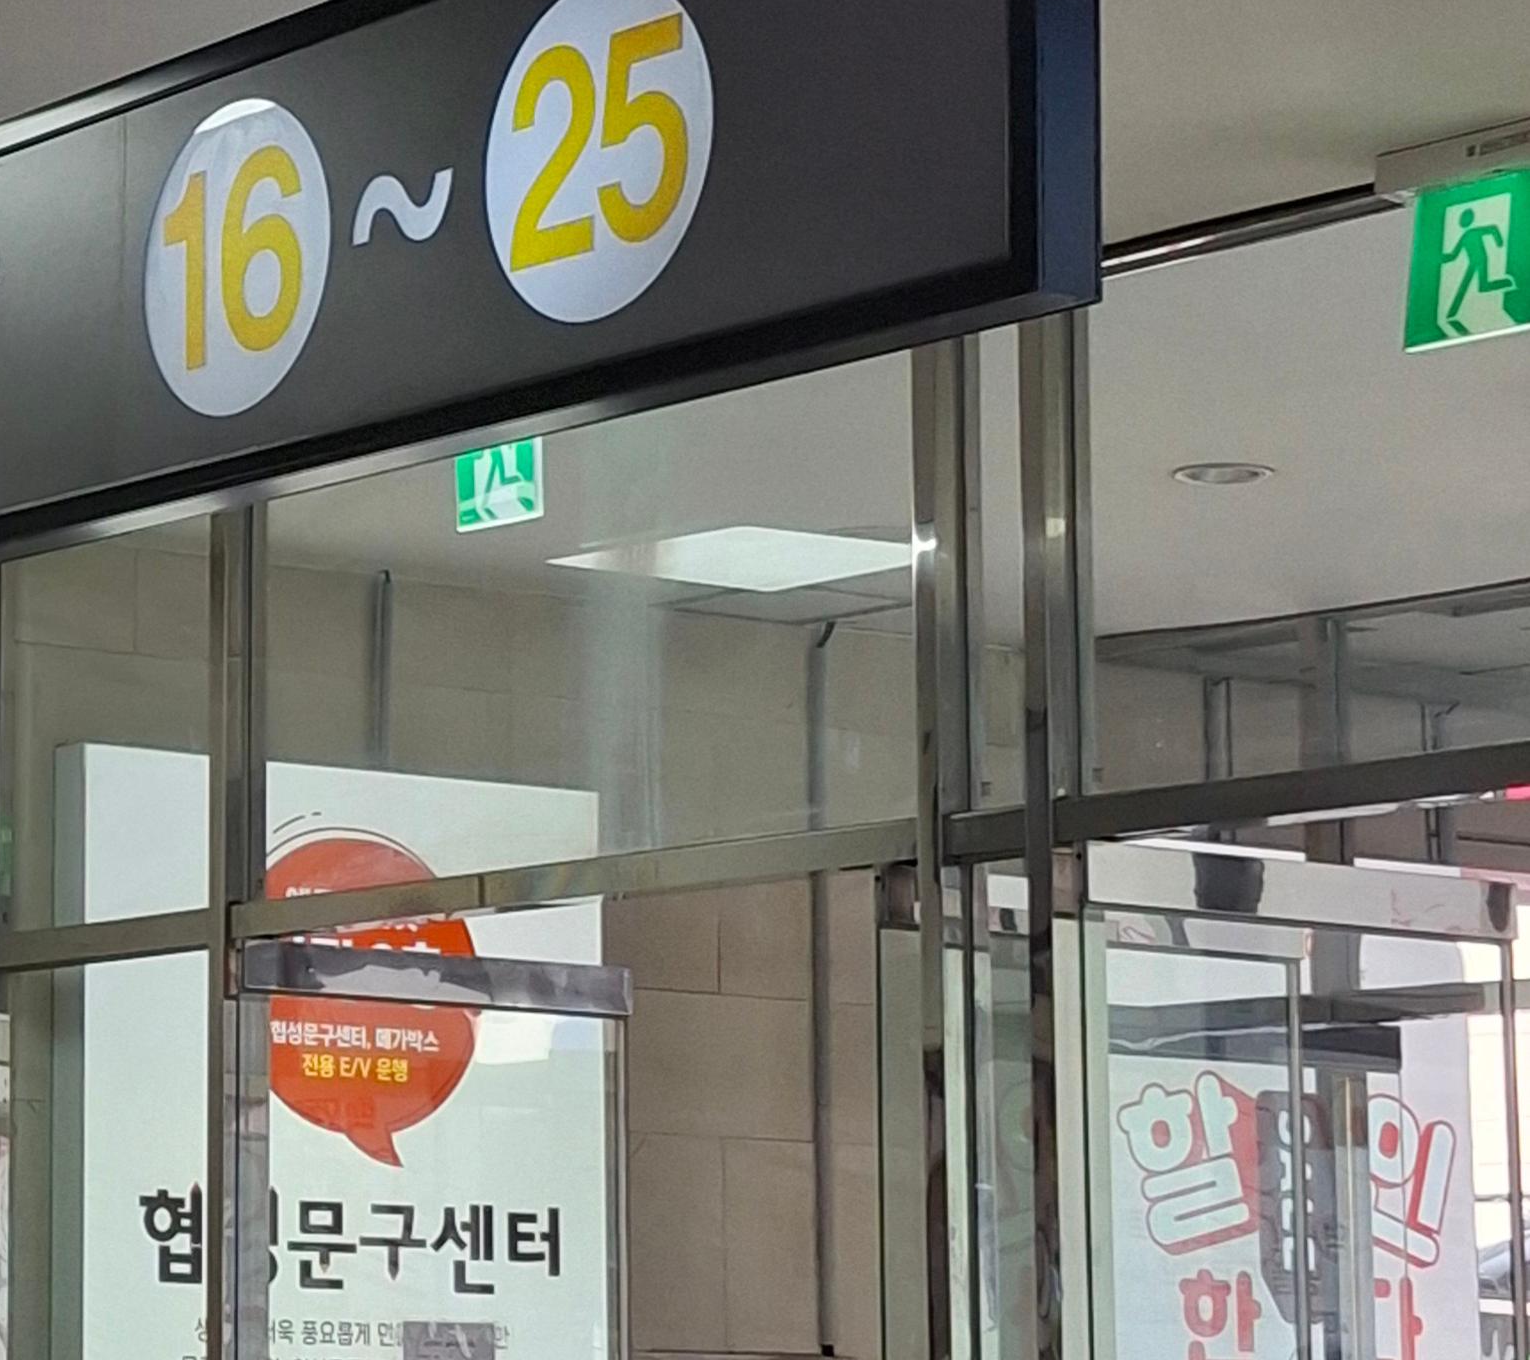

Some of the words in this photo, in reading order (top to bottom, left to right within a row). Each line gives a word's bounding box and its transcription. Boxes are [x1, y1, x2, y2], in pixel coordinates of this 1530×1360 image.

[163, 144, 302, 372] 16
[510, 12, 683, 272] 25
[302, 1053, 334, 1077] 전용
[339, 1056, 370, 1079] E/V
[376, 1057, 408, 1082] 운행
[301, 1320, 371, 1347] 풍요롭게
